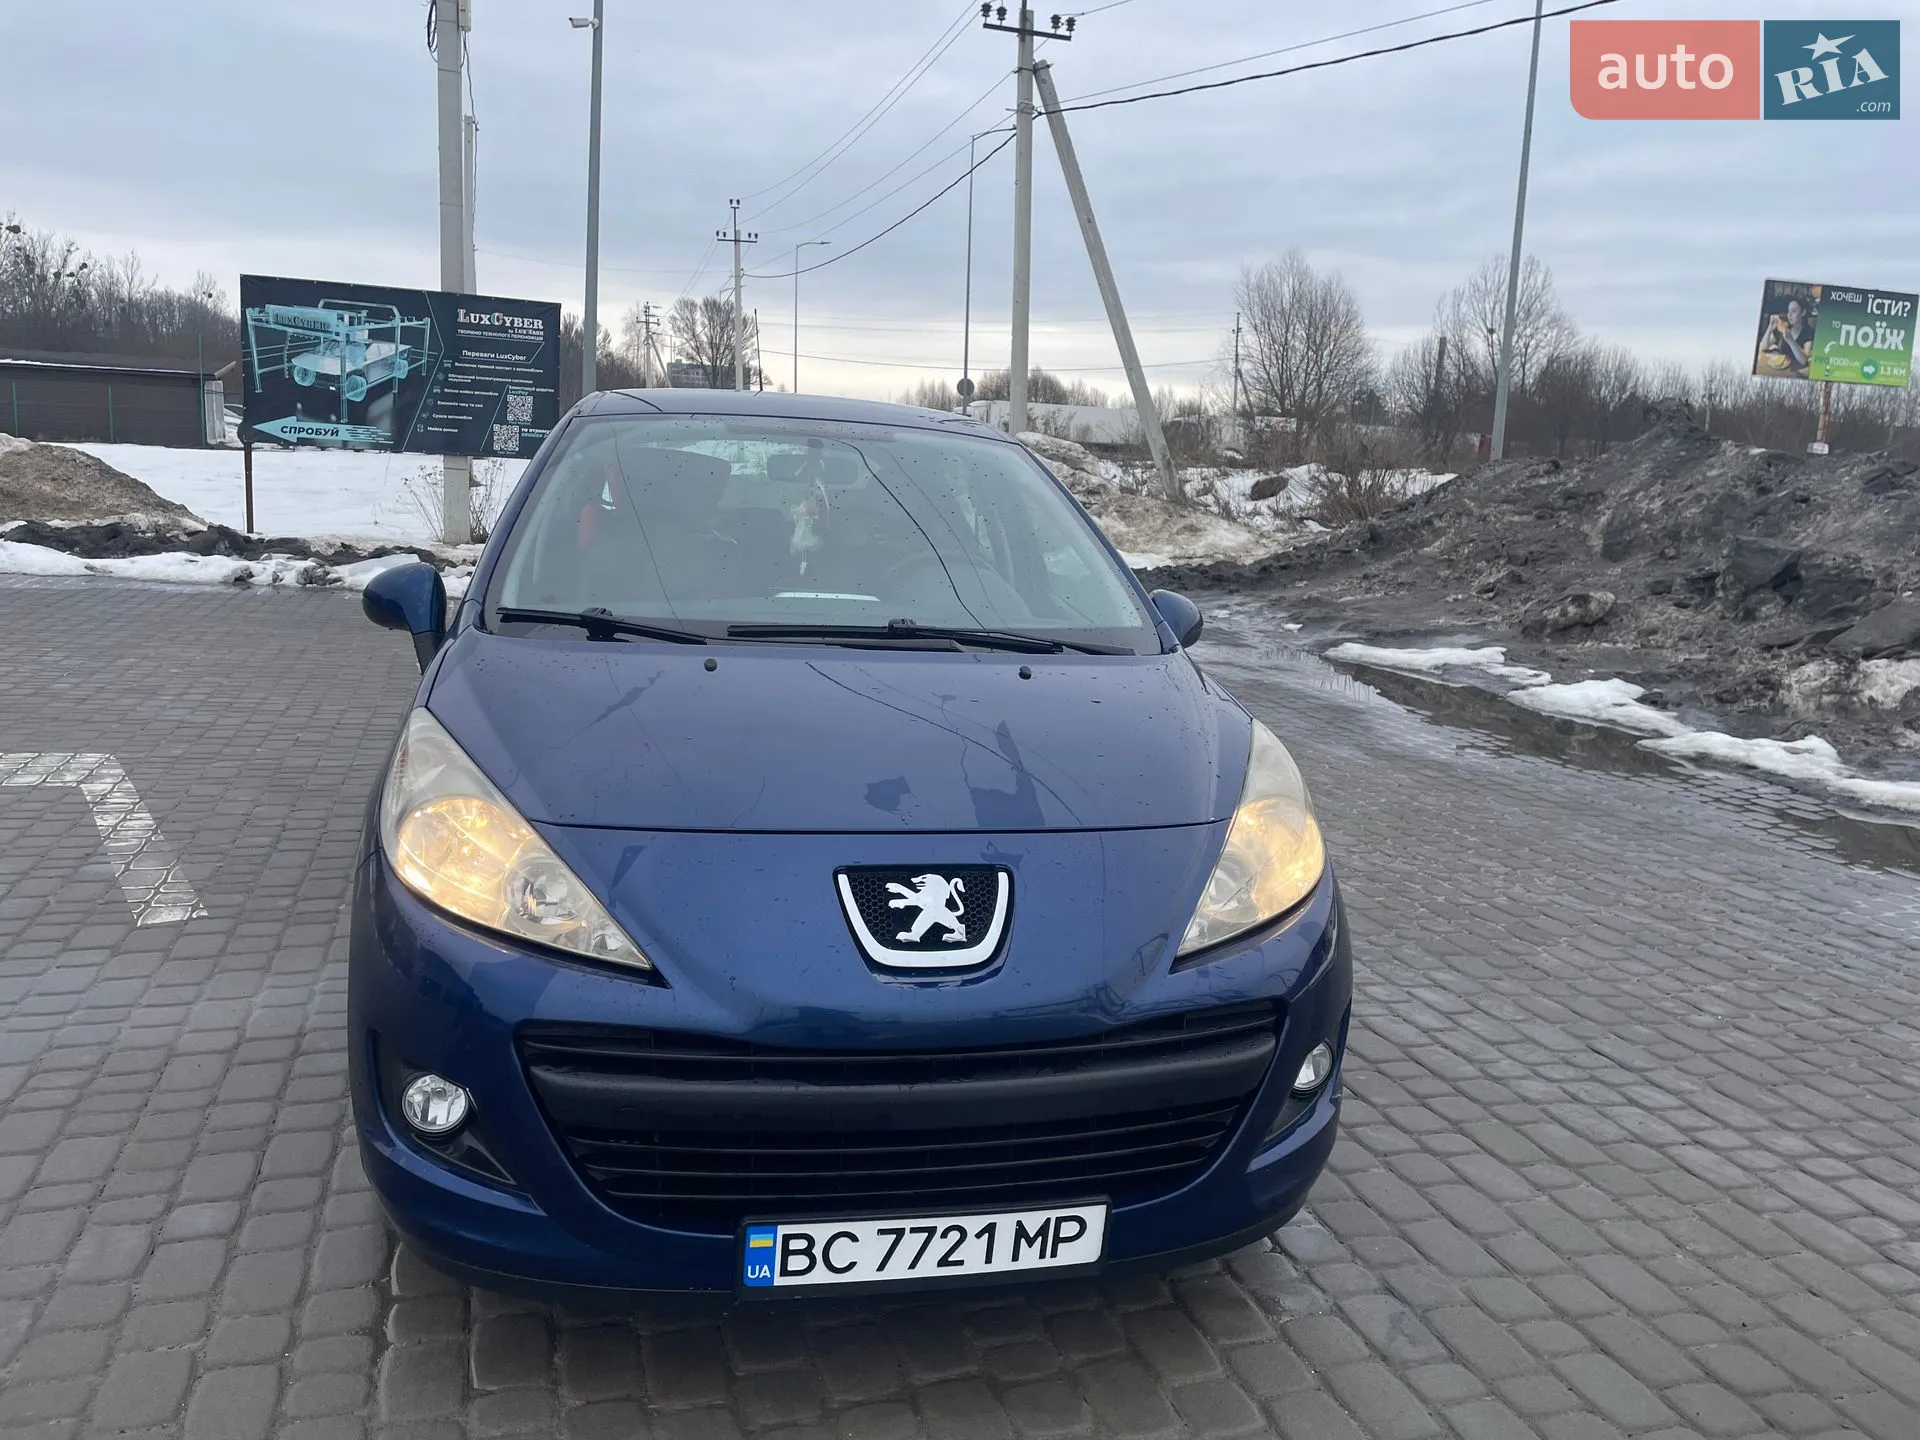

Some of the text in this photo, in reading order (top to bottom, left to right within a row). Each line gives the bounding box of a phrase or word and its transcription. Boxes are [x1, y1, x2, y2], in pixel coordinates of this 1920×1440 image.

[1830, 290, 1911, 317] ХОЧЕШ ЇСТИ?
[1839, 321, 1906, 351] ПОЇЖ
[462, 350, 527, 361] Переваги LuxCyber
[280, 426, 340, 437] СПРОБУЙ
[780, 1215, 1088, 1278] BC 7721 MP
[747, 1264, 771, 1280] UA
